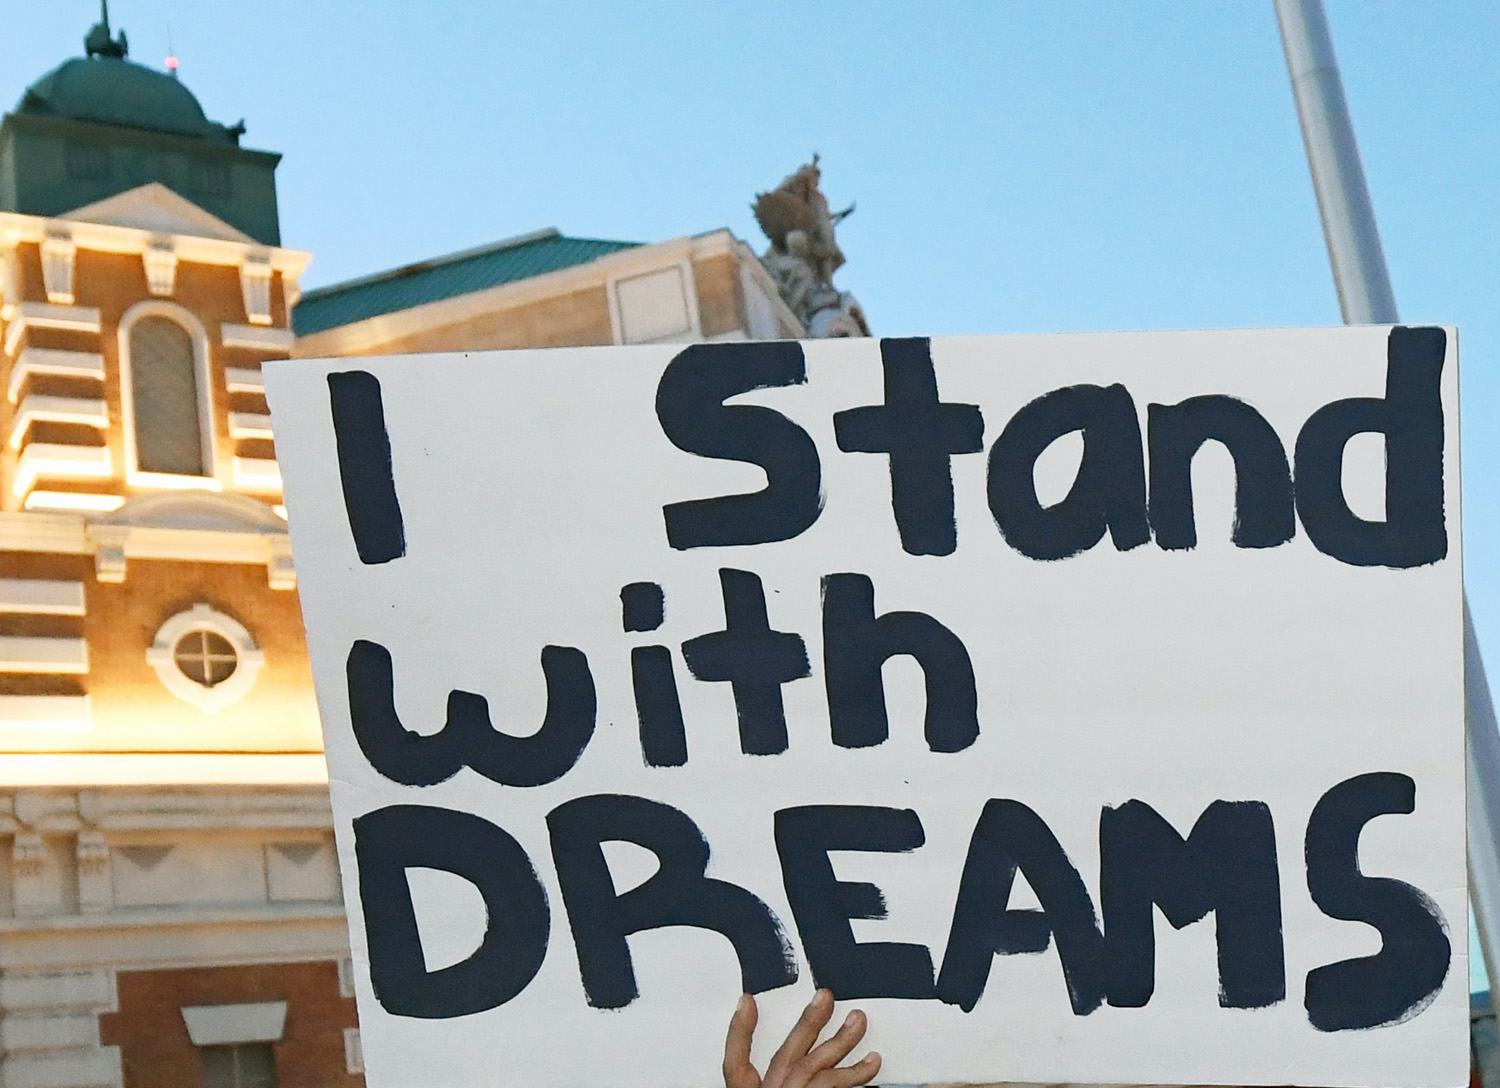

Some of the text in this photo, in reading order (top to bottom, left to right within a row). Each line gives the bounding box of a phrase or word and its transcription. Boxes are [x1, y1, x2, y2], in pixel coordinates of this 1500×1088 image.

[327, 326, 1448, 569] I Stand
[346, 568, 980, 787] with
[352, 772, 1451, 1032] DREAMS
